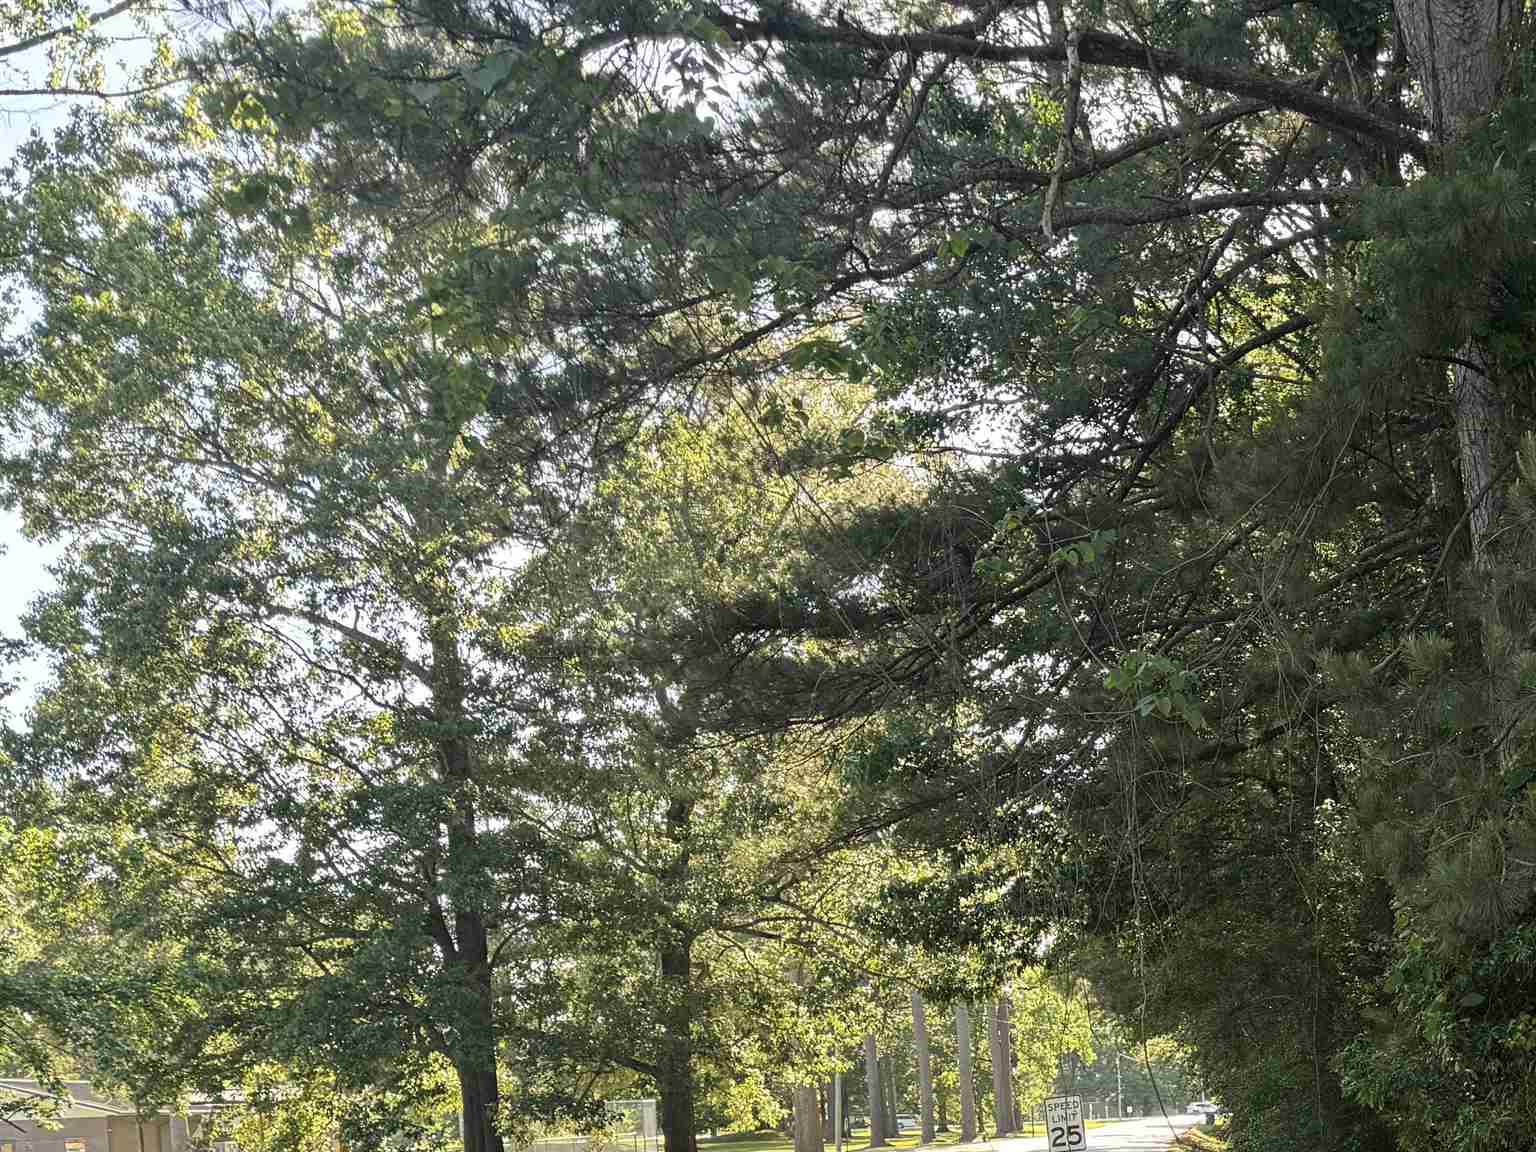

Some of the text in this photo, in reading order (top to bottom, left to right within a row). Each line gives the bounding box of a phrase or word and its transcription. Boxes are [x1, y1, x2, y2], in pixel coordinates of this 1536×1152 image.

[1048, 1100, 1079, 1112] SPEED
[1052, 1111, 1078, 1123] LIMIT
[1051, 1125, 1082, 1147] 25
